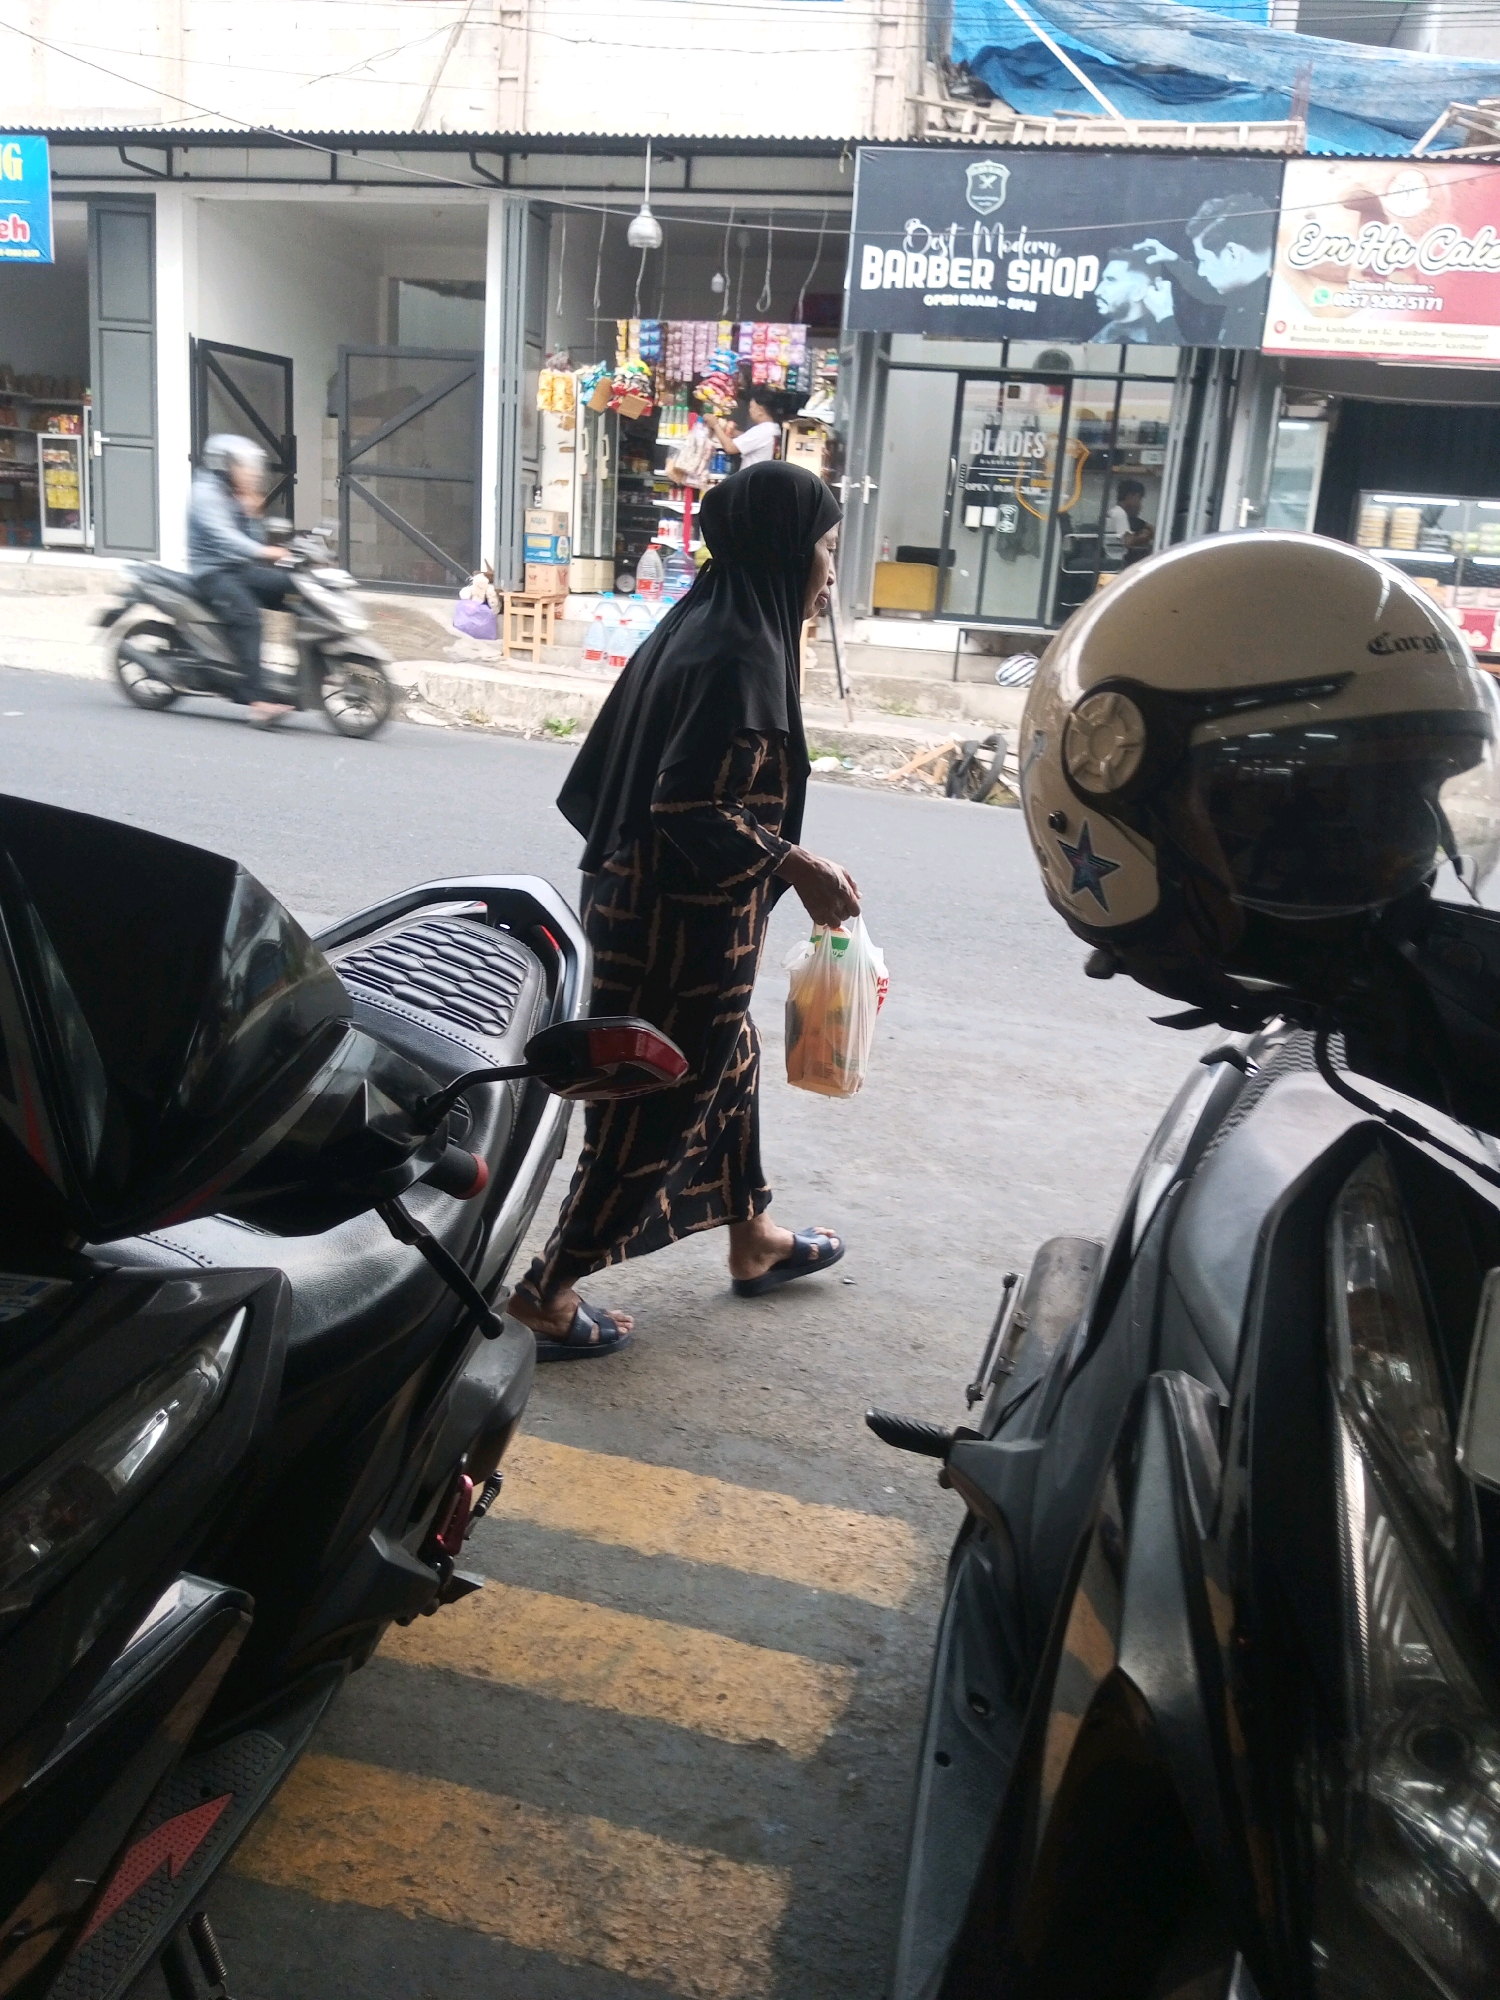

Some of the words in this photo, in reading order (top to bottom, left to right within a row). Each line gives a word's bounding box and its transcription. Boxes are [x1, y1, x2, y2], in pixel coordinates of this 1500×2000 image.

[0, 143, 23, 181] G
[972, 220, 1061, 259] Modern
[1288, 222, 1356, 266] Em
[1359, 224, 1417, 271] Ha
[860, 244, 994, 290] BARBER
[1007, 255, 1099, 300] SHOP
[923, 294, 959, 306] OPEN
[969, 429, 1047, 458] BLADES
